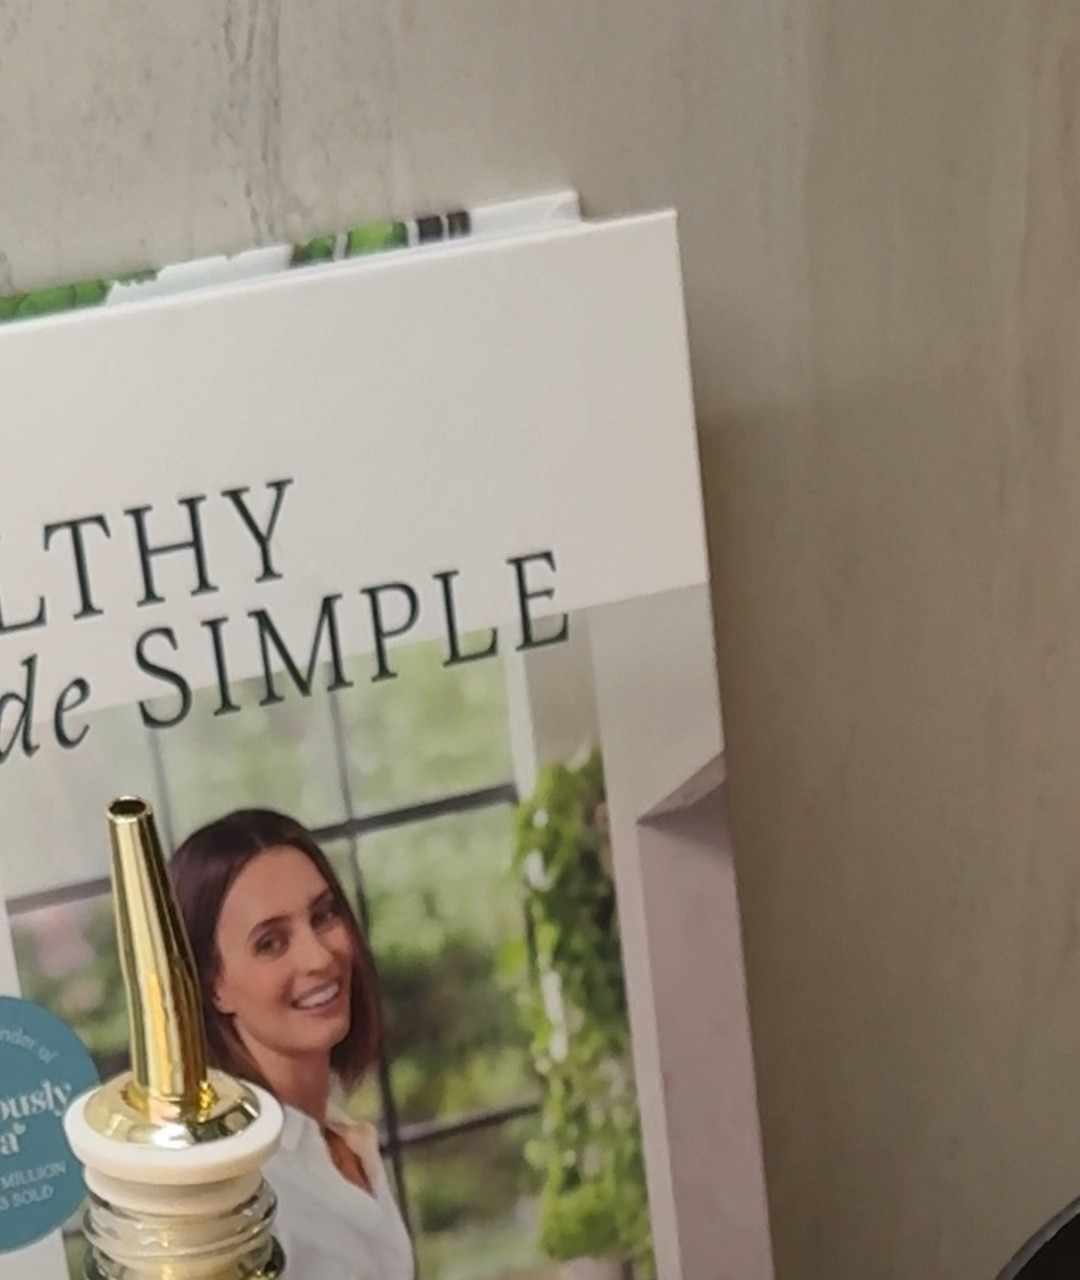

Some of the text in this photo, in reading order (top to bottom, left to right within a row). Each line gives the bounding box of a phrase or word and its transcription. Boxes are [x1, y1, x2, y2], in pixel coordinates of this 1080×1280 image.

[0, 550, 570, 764] de SIMPLE
[12, 1184, 54, 1208] SOLD
